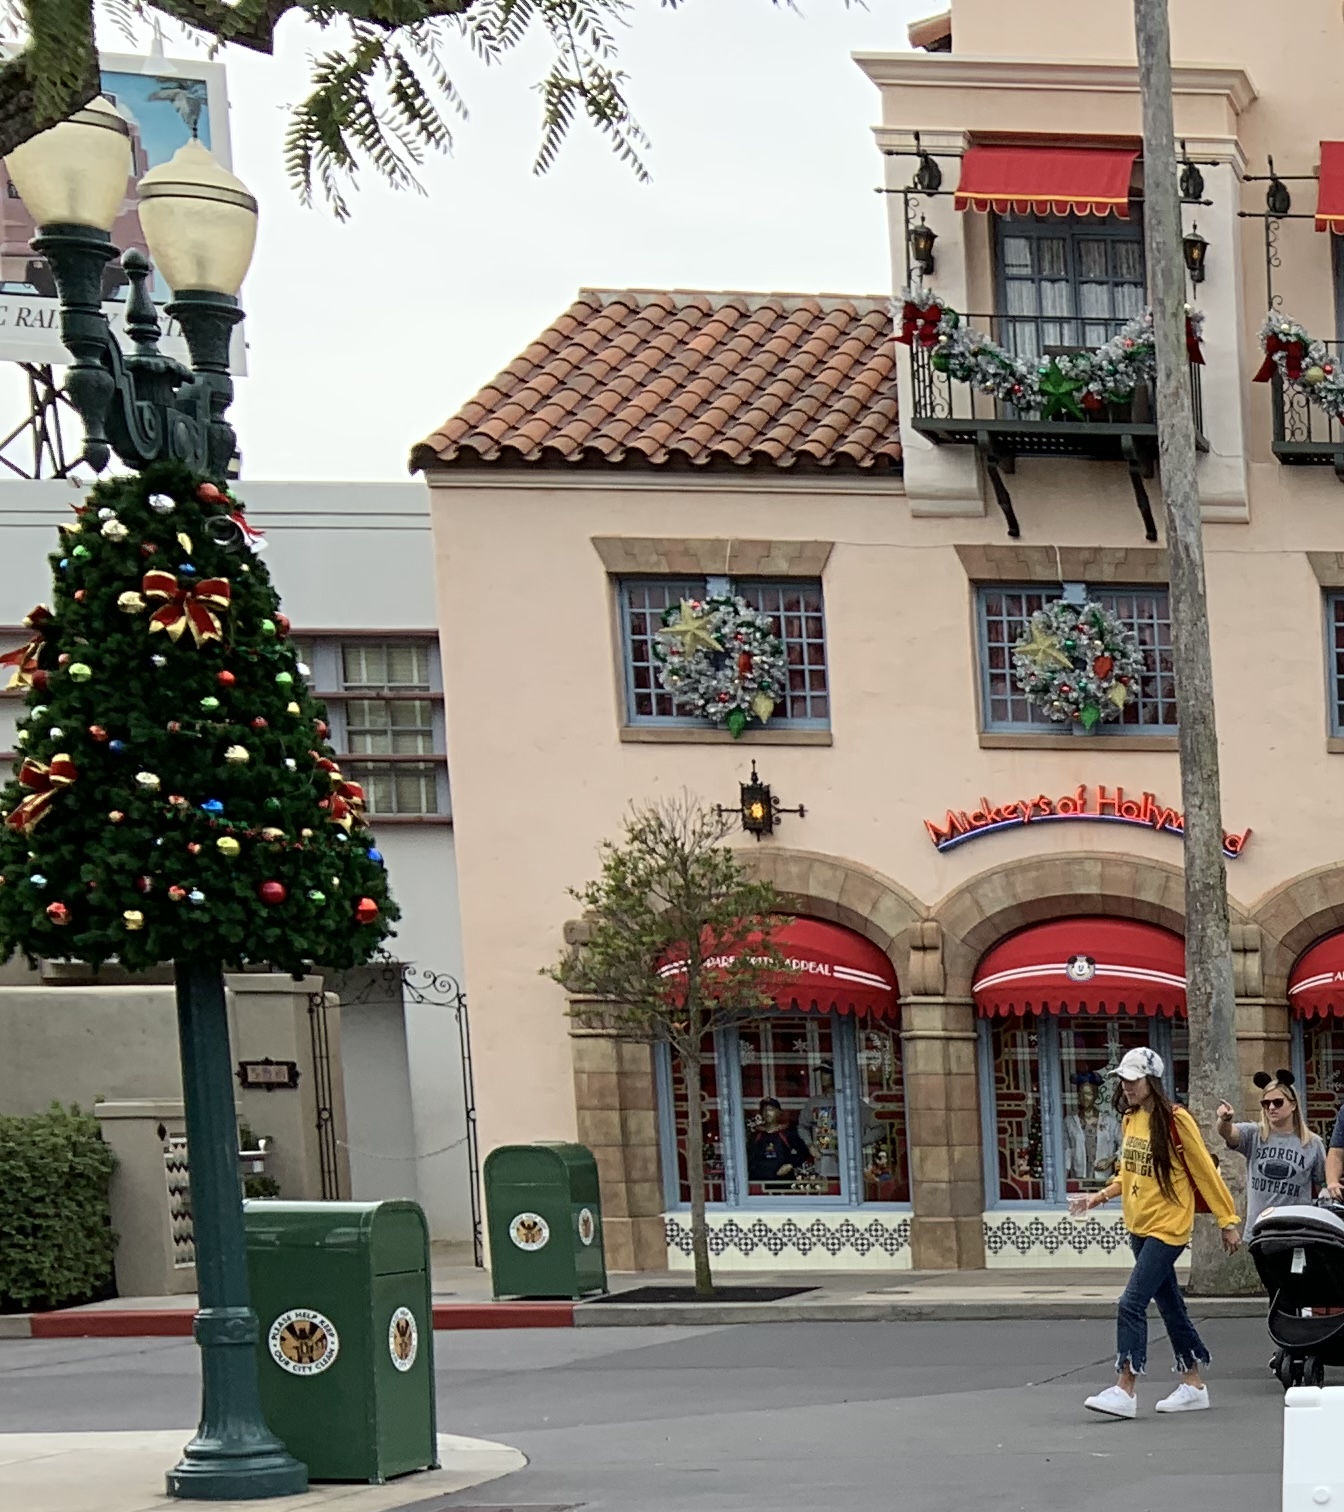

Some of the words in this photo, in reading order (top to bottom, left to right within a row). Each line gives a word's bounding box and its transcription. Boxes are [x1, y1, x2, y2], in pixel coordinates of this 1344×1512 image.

[1057, 784, 1087, 816] of
[1097, 785, 1252, 852] Hollywd
[1256, 1147, 1305, 1169] GEORGIA
[1252, 1177, 1301, 1197] SOUTHERN
